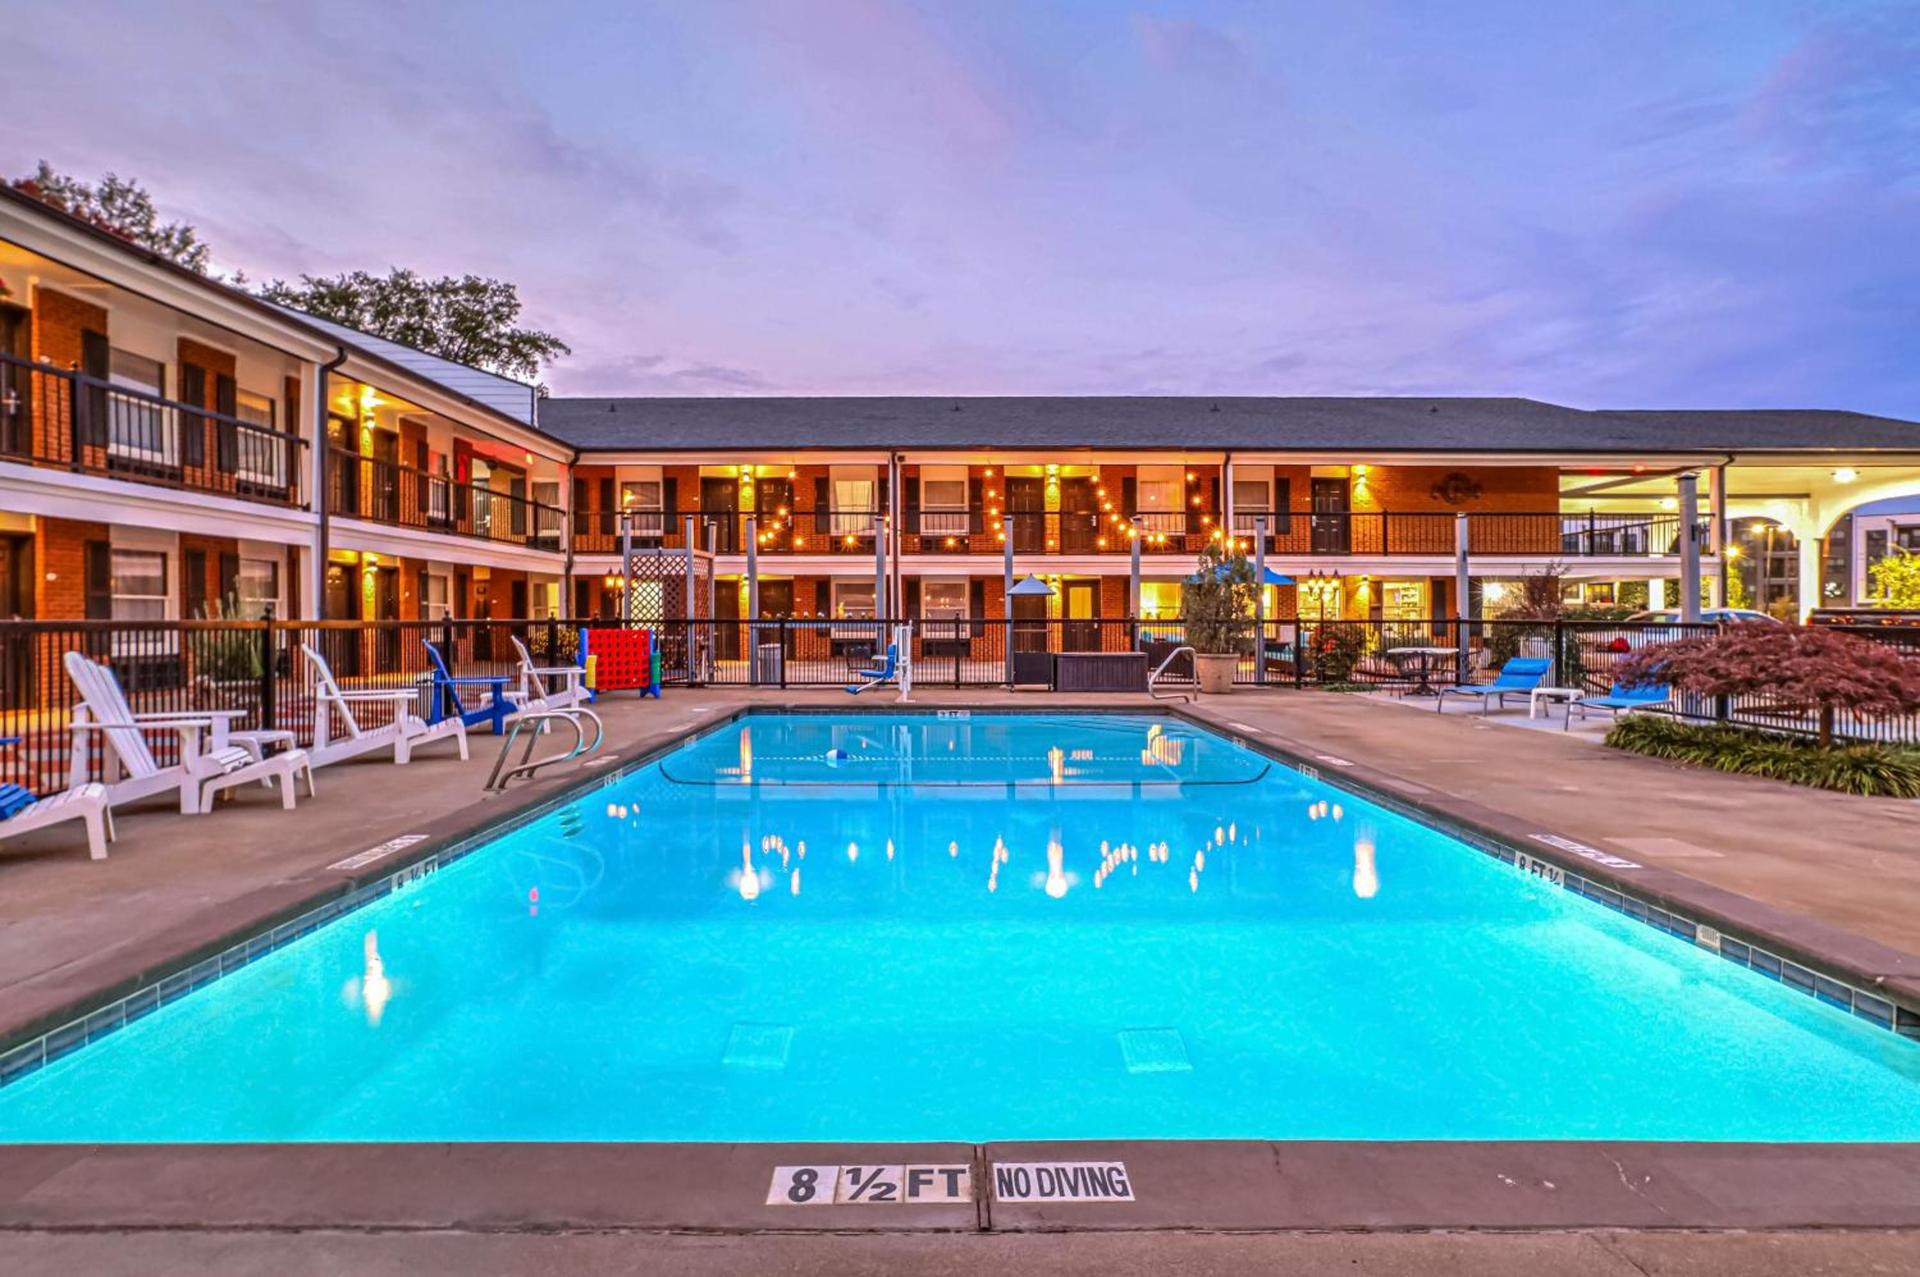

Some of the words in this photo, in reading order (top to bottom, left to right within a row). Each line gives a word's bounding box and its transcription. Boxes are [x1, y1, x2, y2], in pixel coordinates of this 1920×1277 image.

[424, 858, 436, 877] FT
[1530, 860, 1546, 878] FT
[787, 1168, 819, 1203] 8
[908, 1168, 968, 1198] FT
[996, 1167, 1032, 1198] NO
[1037, 1165, 1131, 1198] DIVING
